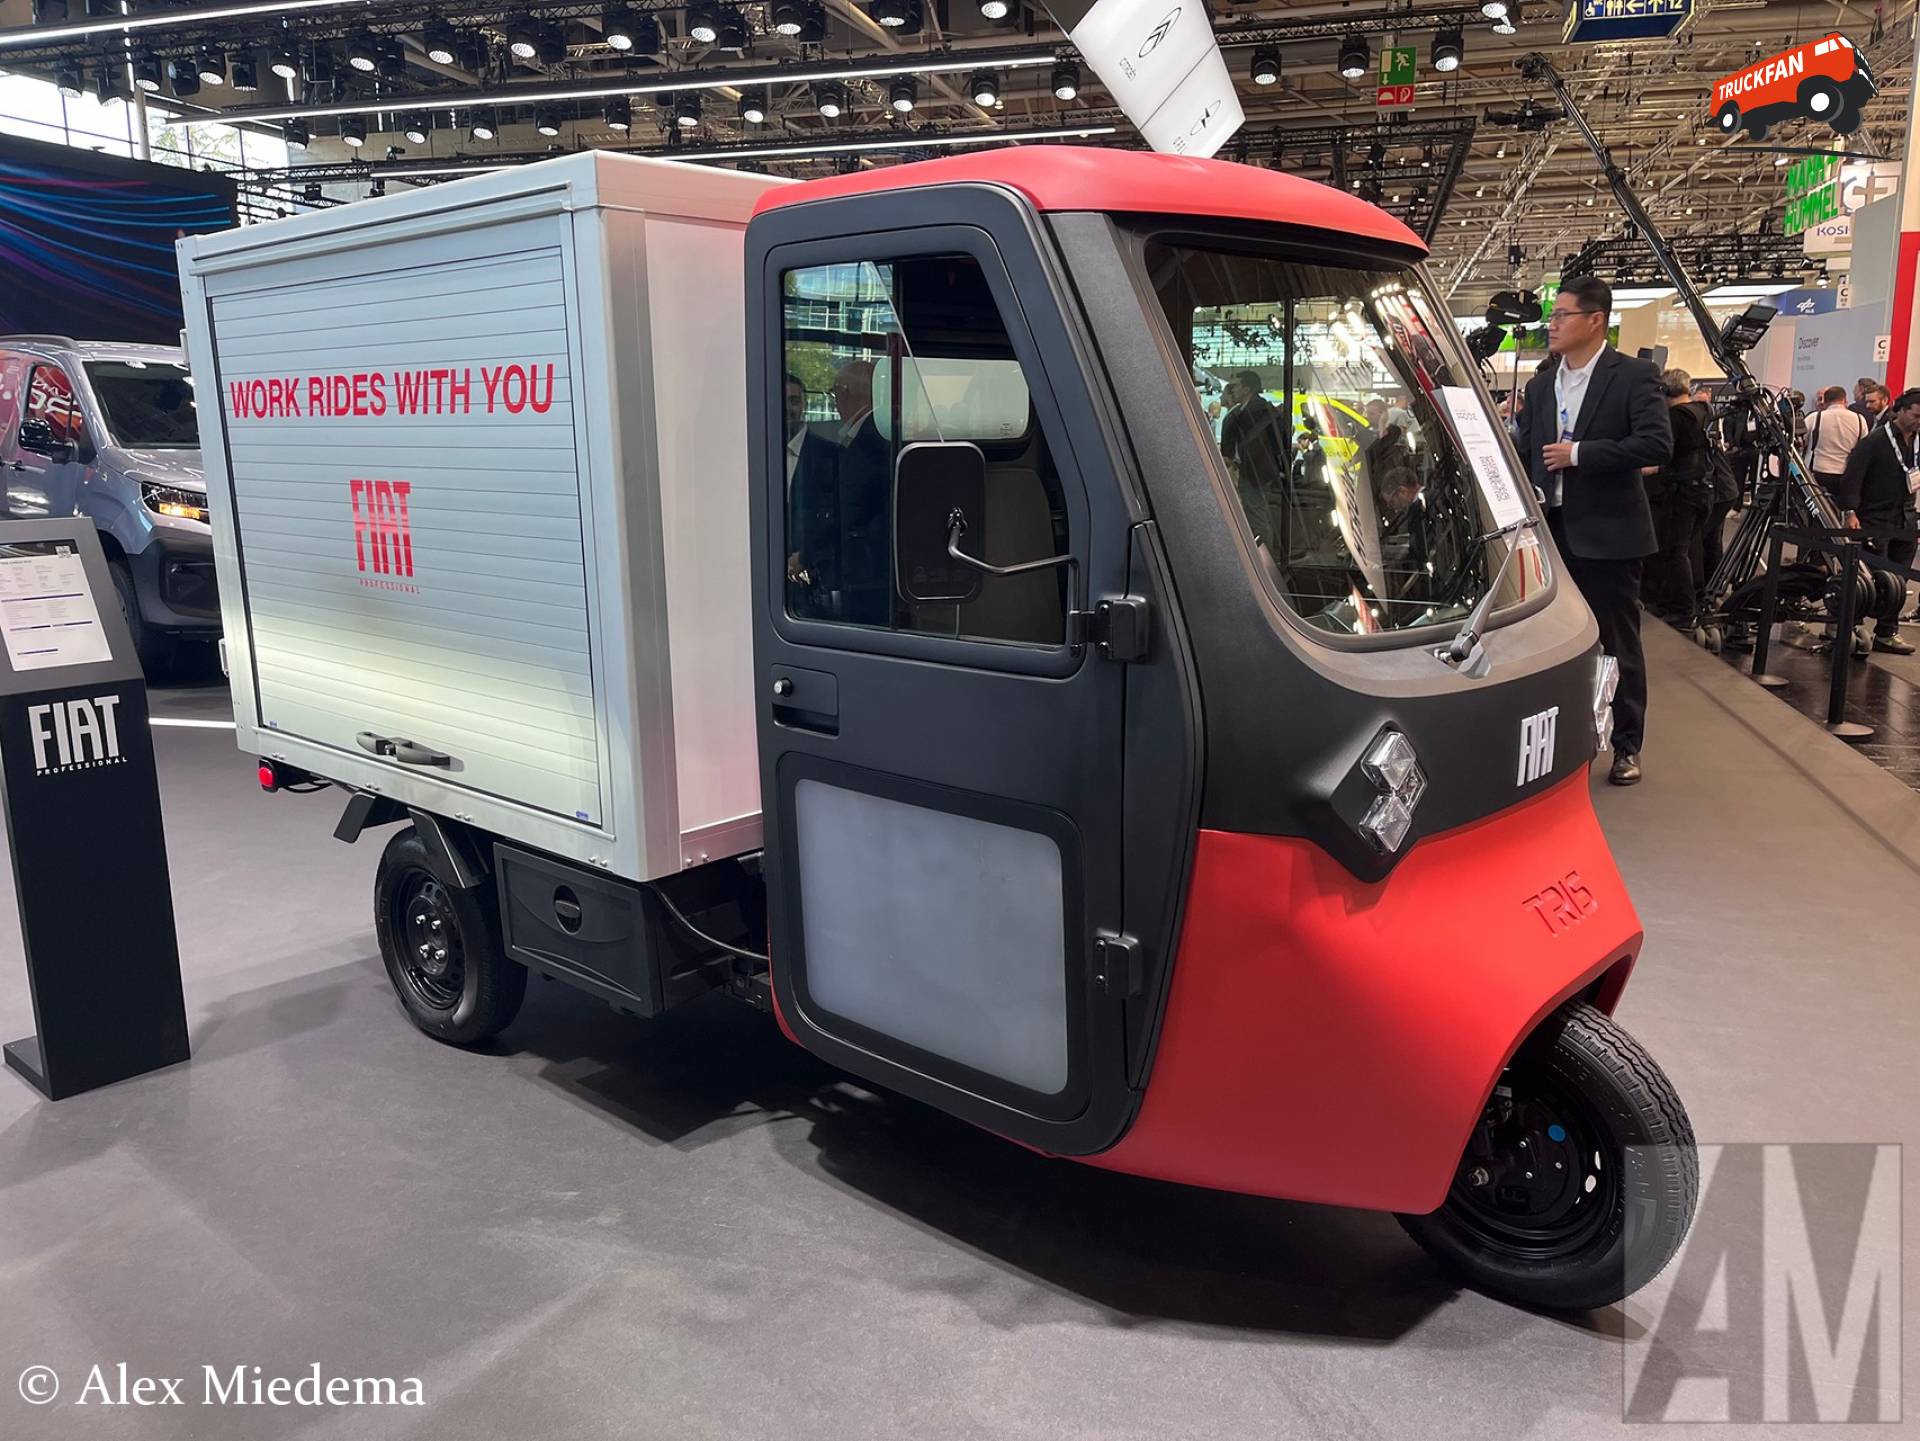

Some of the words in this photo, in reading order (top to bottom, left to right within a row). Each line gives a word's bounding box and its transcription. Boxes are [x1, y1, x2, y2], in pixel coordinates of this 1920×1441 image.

[1840, 287, 1849, 297] C
[1878, 339, 1887, 350] C
[229, 377, 302, 418] WORK
[308, 372, 387, 416] RIDES
[394, 367, 471, 415] WITH
[481, 363, 554, 414] YOU
[349, 478, 414, 577] FIAT
[27, 694, 120, 769] FIAT
[1516, 706, 1560, 786] FIAT
[36, 757, 128, 776] PROFESSIONAL
[1521, 869, 1598, 938] TRIS
